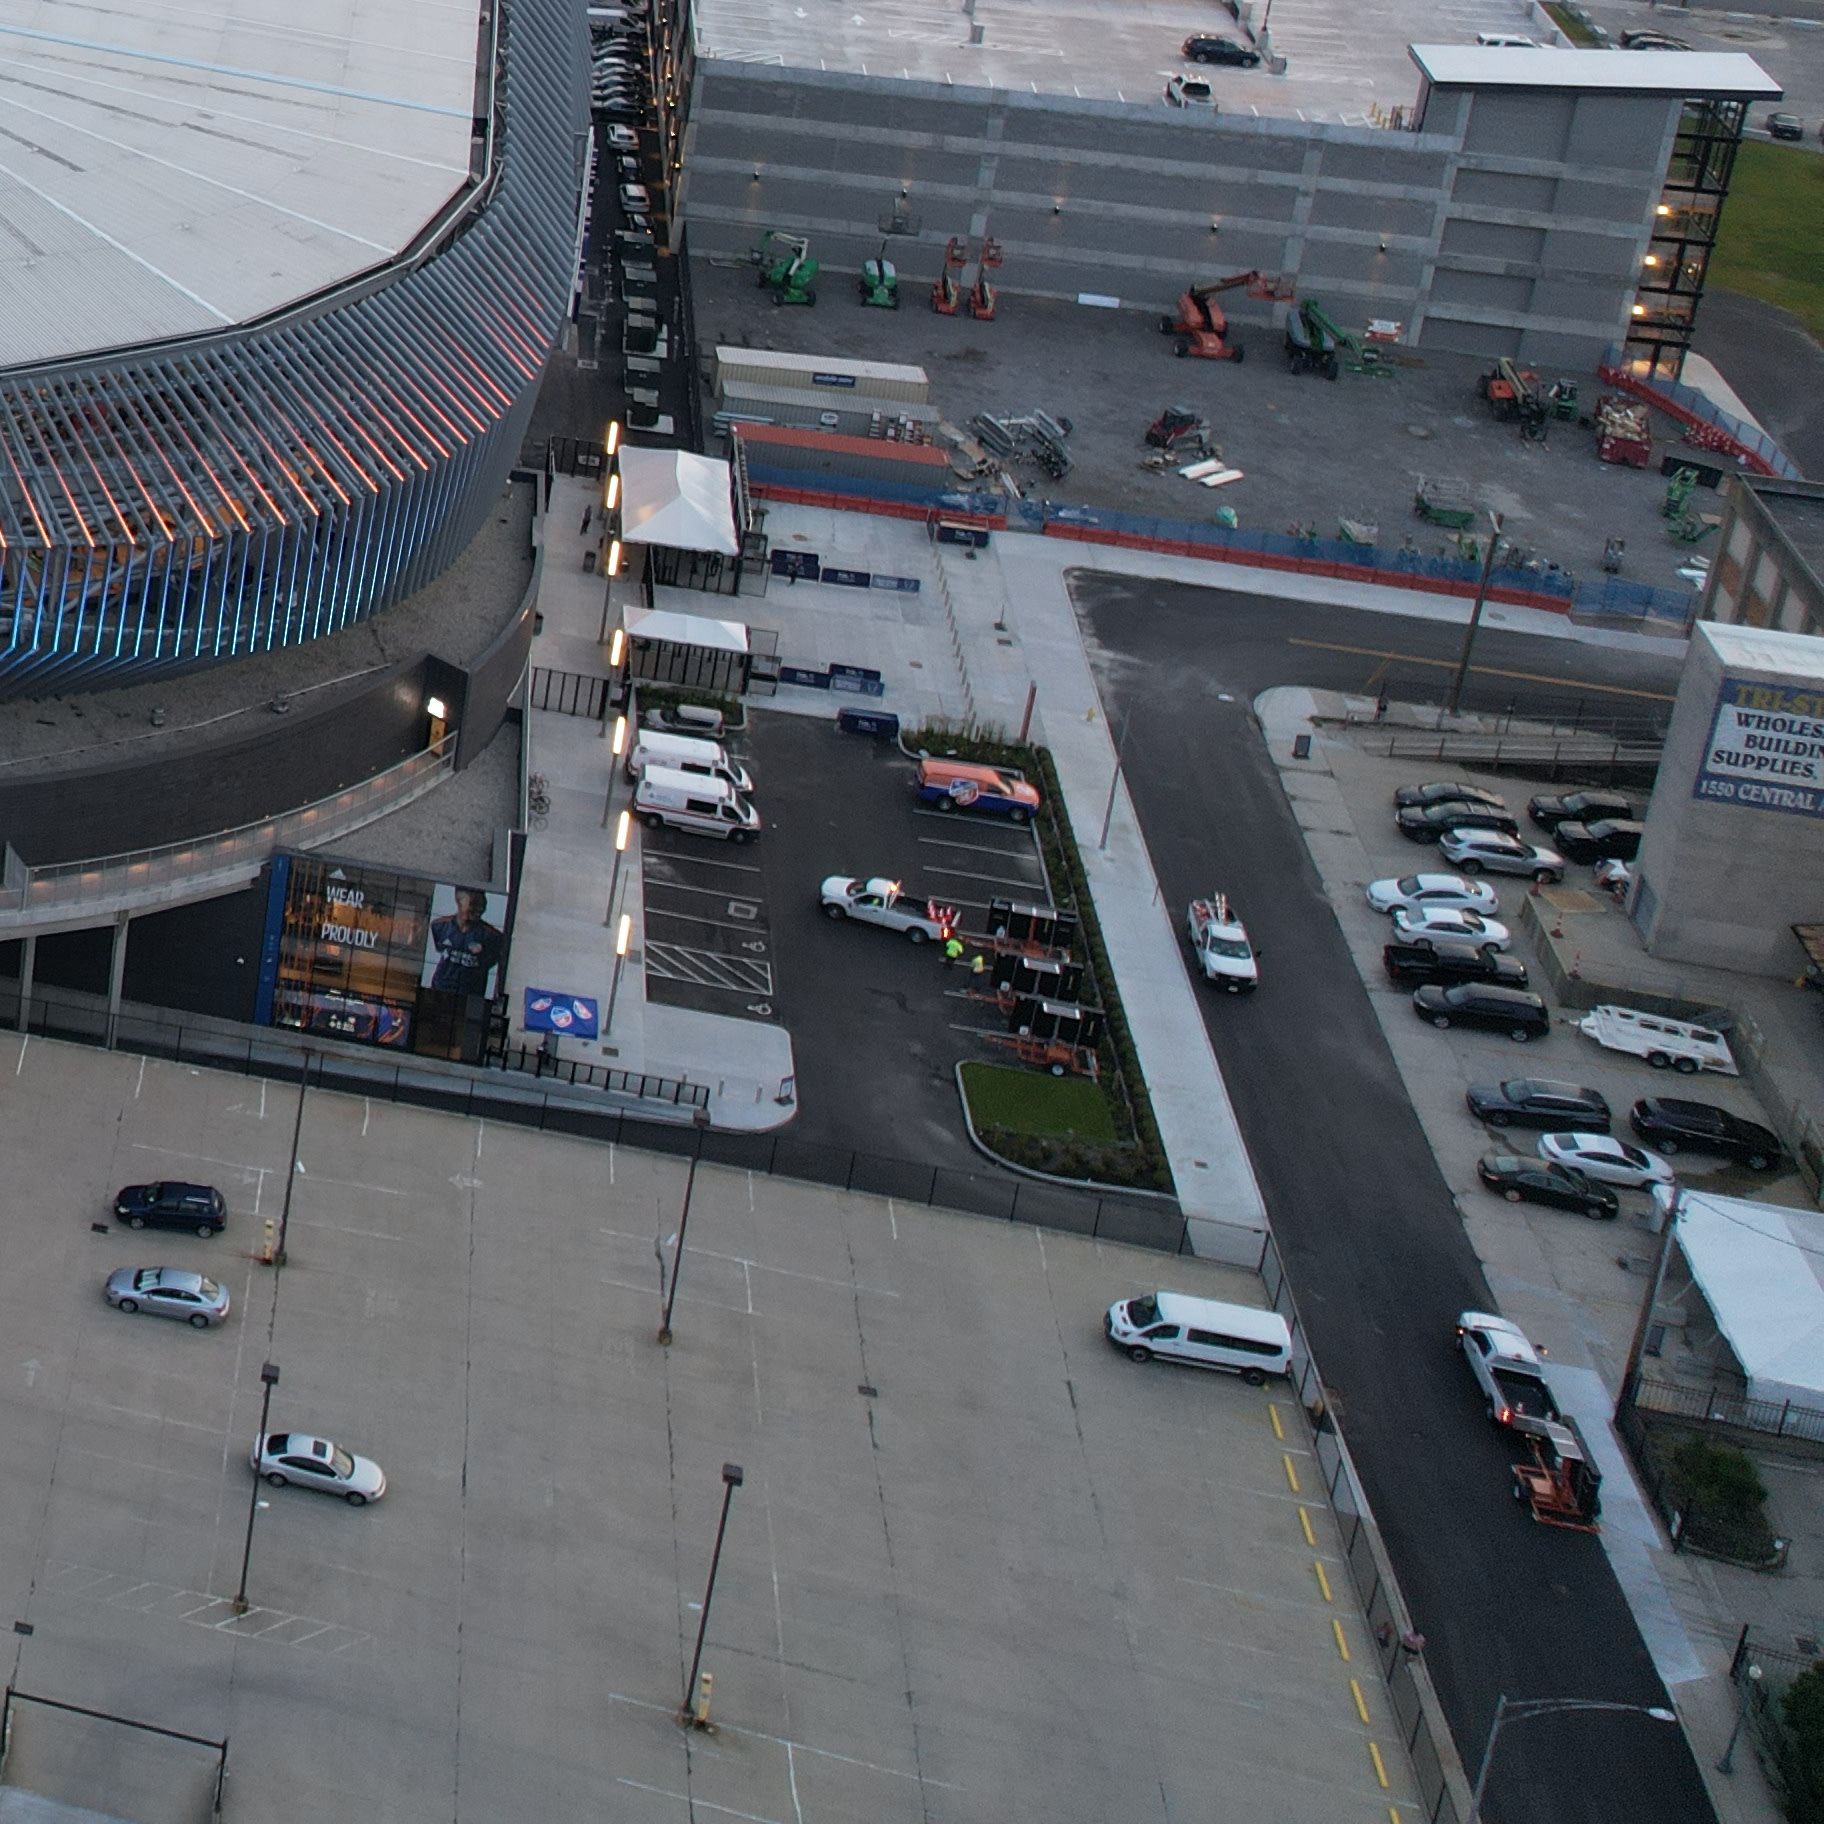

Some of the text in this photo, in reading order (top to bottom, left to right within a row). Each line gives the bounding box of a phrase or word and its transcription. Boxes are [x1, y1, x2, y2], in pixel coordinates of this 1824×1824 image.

[1738, 783, 1816, 810] CENTRAL
[326, 885, 364, 909] WEAR
[321, 923, 379, 949] PROUDLY
